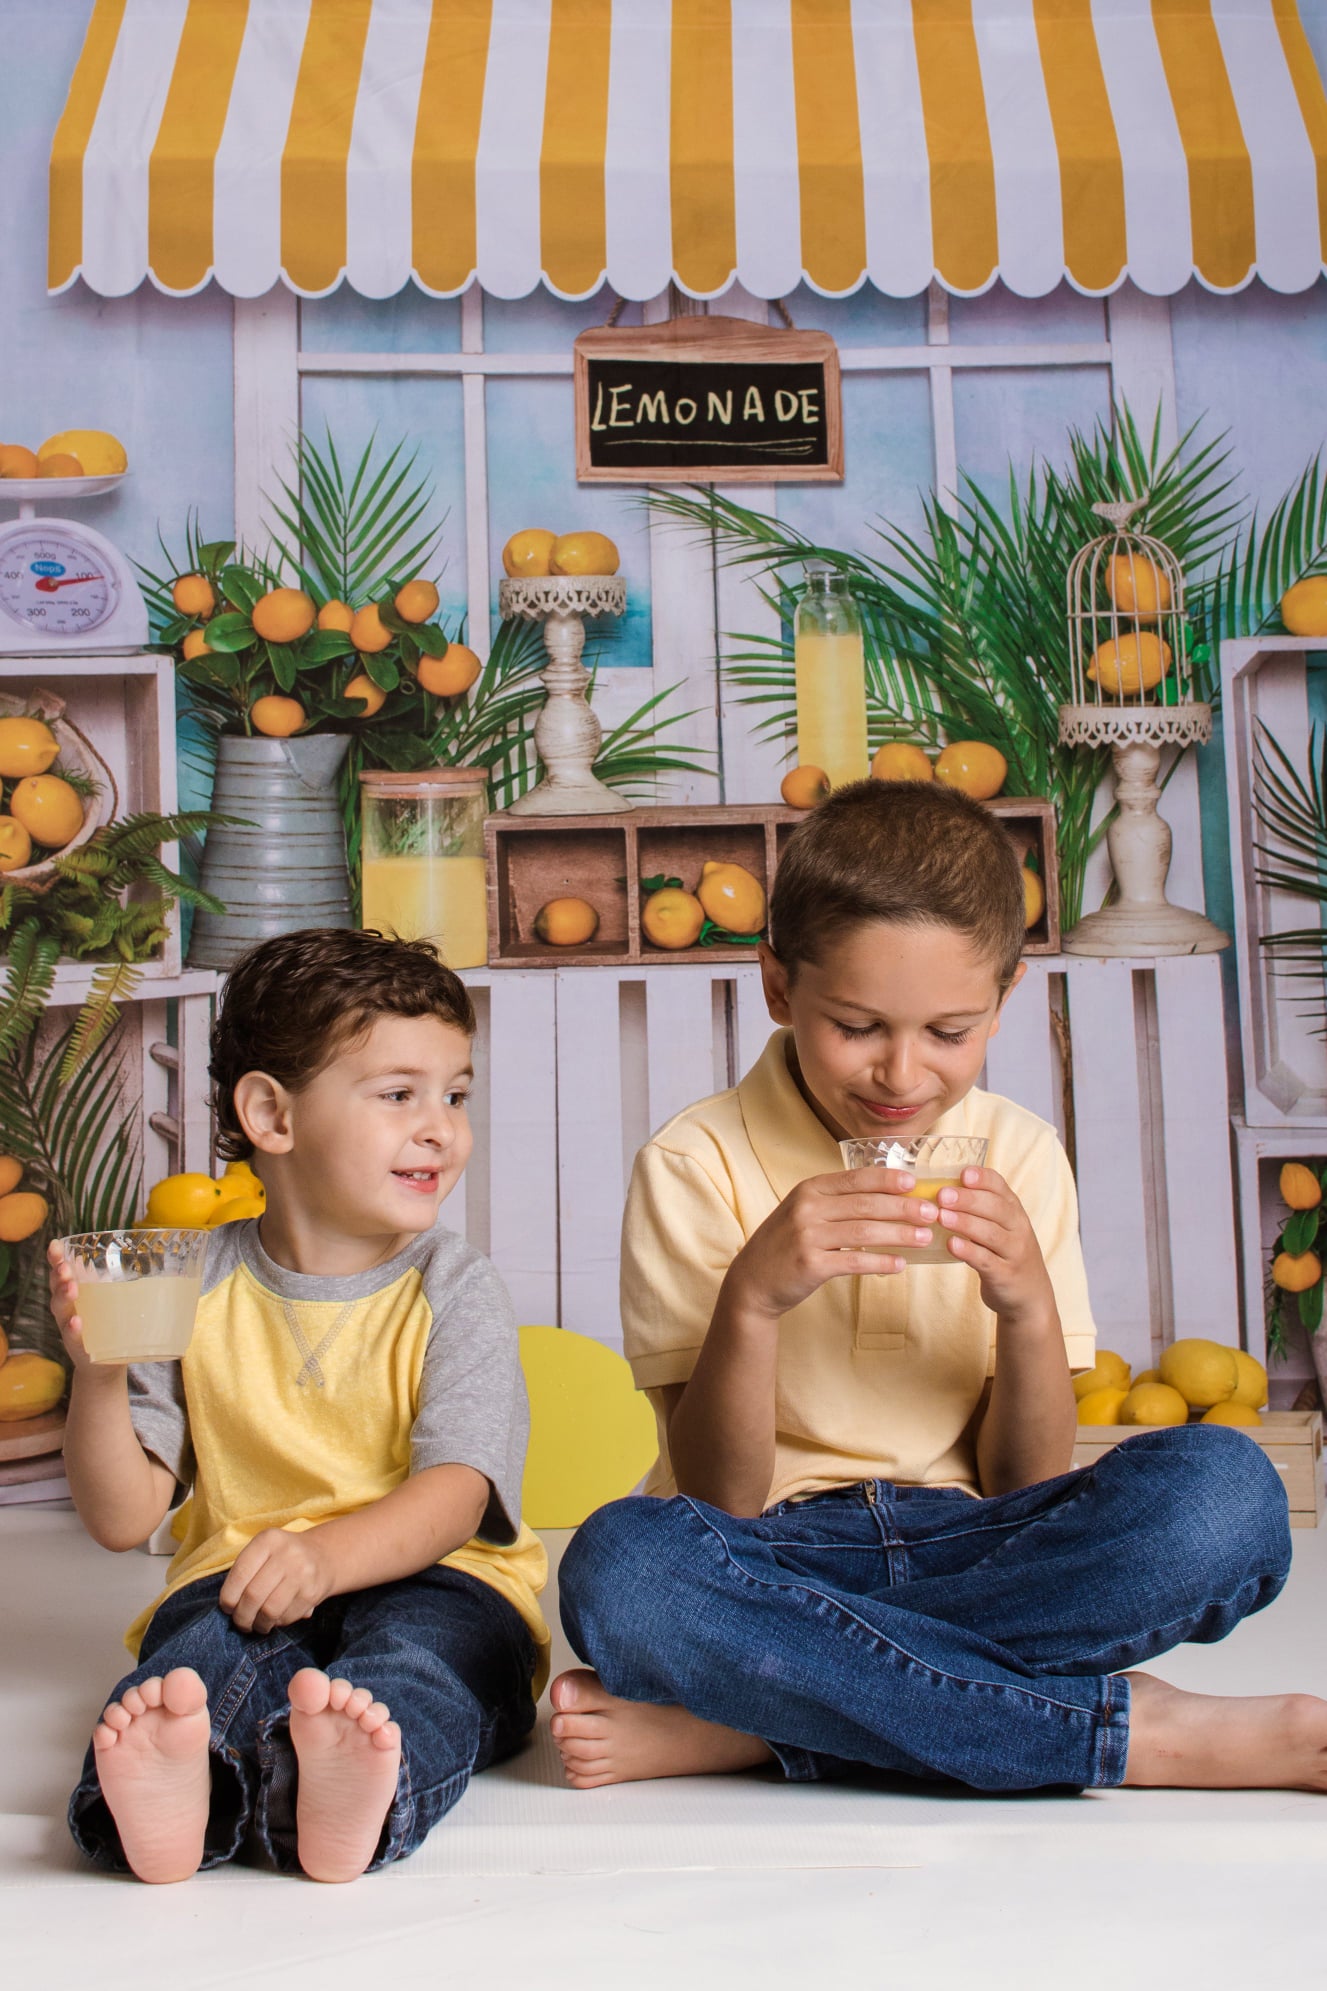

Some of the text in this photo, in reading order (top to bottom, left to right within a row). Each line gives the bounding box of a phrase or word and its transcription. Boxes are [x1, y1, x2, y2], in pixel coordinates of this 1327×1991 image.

[591, 381, 819, 431] LEMONADE
[27, 608, 46, 616] 300
[71, 608, 90, 616] 200
